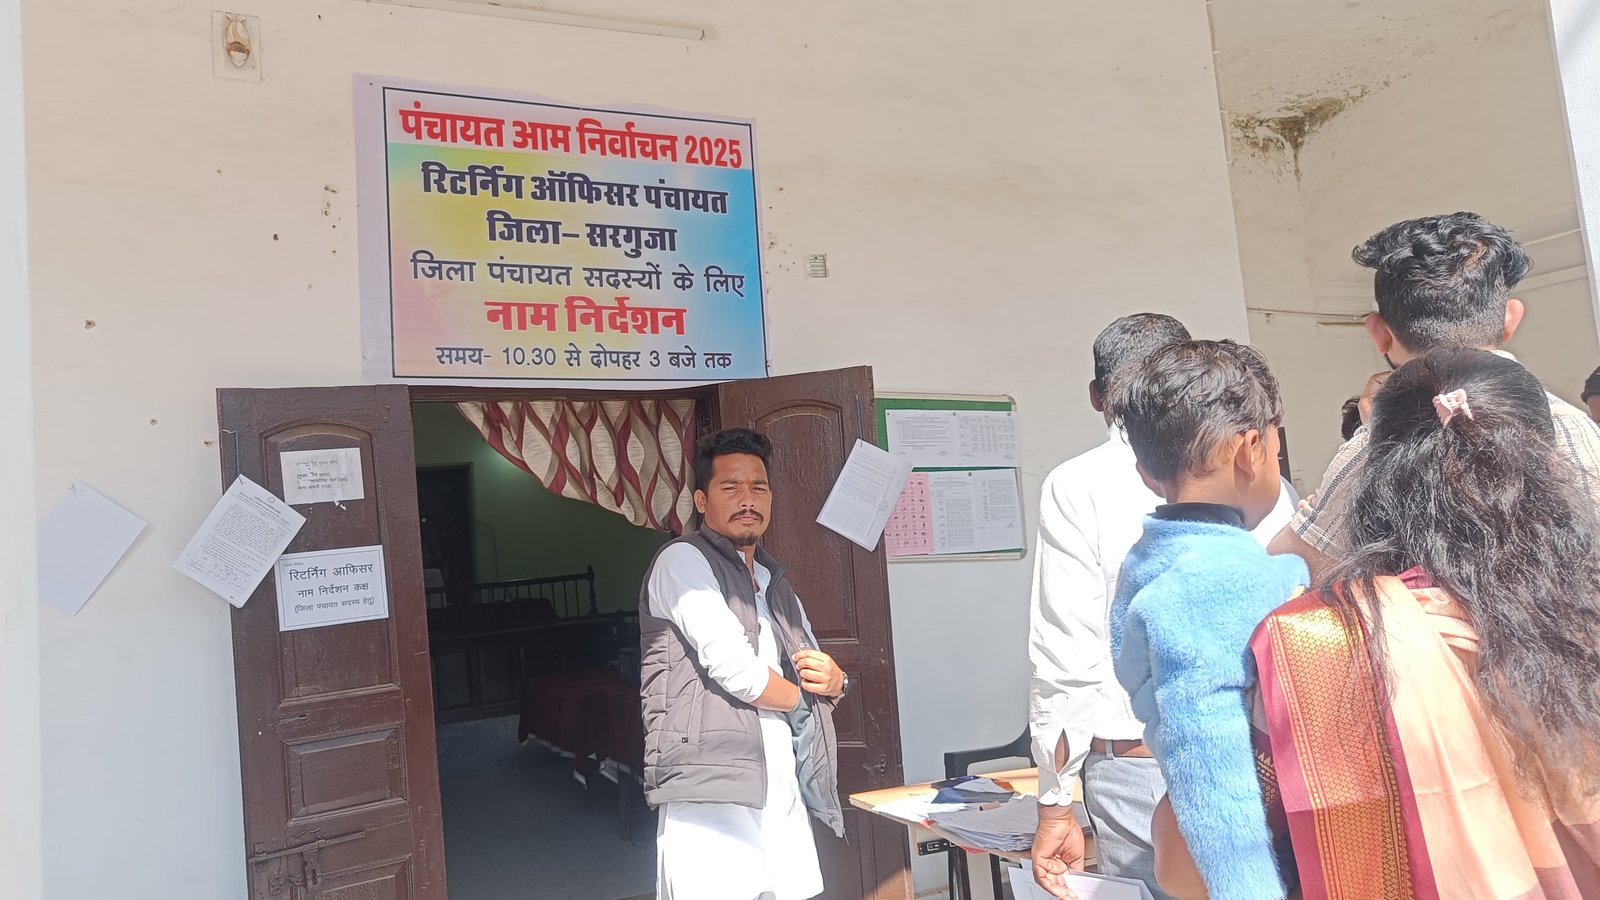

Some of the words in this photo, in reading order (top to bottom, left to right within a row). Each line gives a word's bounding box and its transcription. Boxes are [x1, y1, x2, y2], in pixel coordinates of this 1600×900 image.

[399, 101, 505, 147] पंचायत
[512, 120, 571, 153] आम
[576, 117, 678, 163] निर्वाचन
[684, 135, 742, 169] 2025
[530, 170, 639, 208] ऑफिसर
[643, 178, 728, 214] पंचायत
[585, 223, 678, 259] सरगुजा
[410, 249, 477, 282] जिला
[487, 255, 573, 286] पंचायत
[582, 261, 662, 290] सदस्यों
[672, 263, 695, 291] के
[704, 265, 745, 298] लिए
[484, 301, 559, 332] नाम
[564, 295, 687, 335] निर्देशन
[502, 347, 557, 366] 10.30
[564, 342, 582, 367] से
[589, 343, 641, 370] दोपहर
[649, 350, 661, 367] 3
[668, 345, 697, 369] बजे
[703, 352, 732, 369] तक
[297, 589, 314, 598] नाम
[319, 584, 349, 596] निर्देशन
[354, 582, 369, 592] कक्ष
